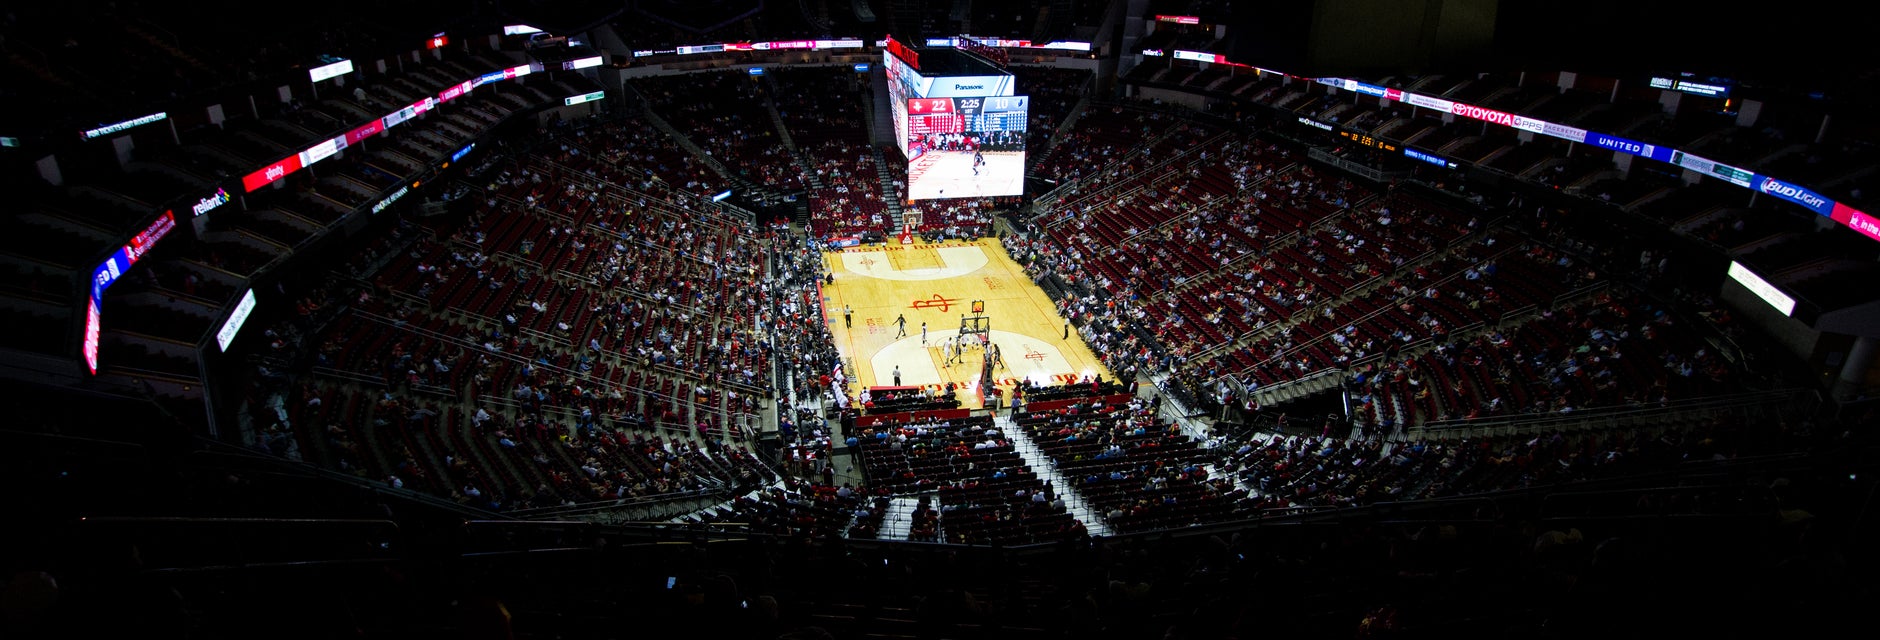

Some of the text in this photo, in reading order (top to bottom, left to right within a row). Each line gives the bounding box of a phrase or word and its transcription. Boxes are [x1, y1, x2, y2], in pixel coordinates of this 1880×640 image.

[932, 100, 946, 111] 22
[961, 99, 980, 109] 2:25
[995, 99, 1008, 109] 10
[1466, 107, 1512, 126] TOYOTA
[1522, 120, 1543, 131] PPS
[1598, 137, 1641, 153] UNITED
[1767, 181, 1825, 208] BUD LIGHT
[193, 193, 223, 216] reliant
